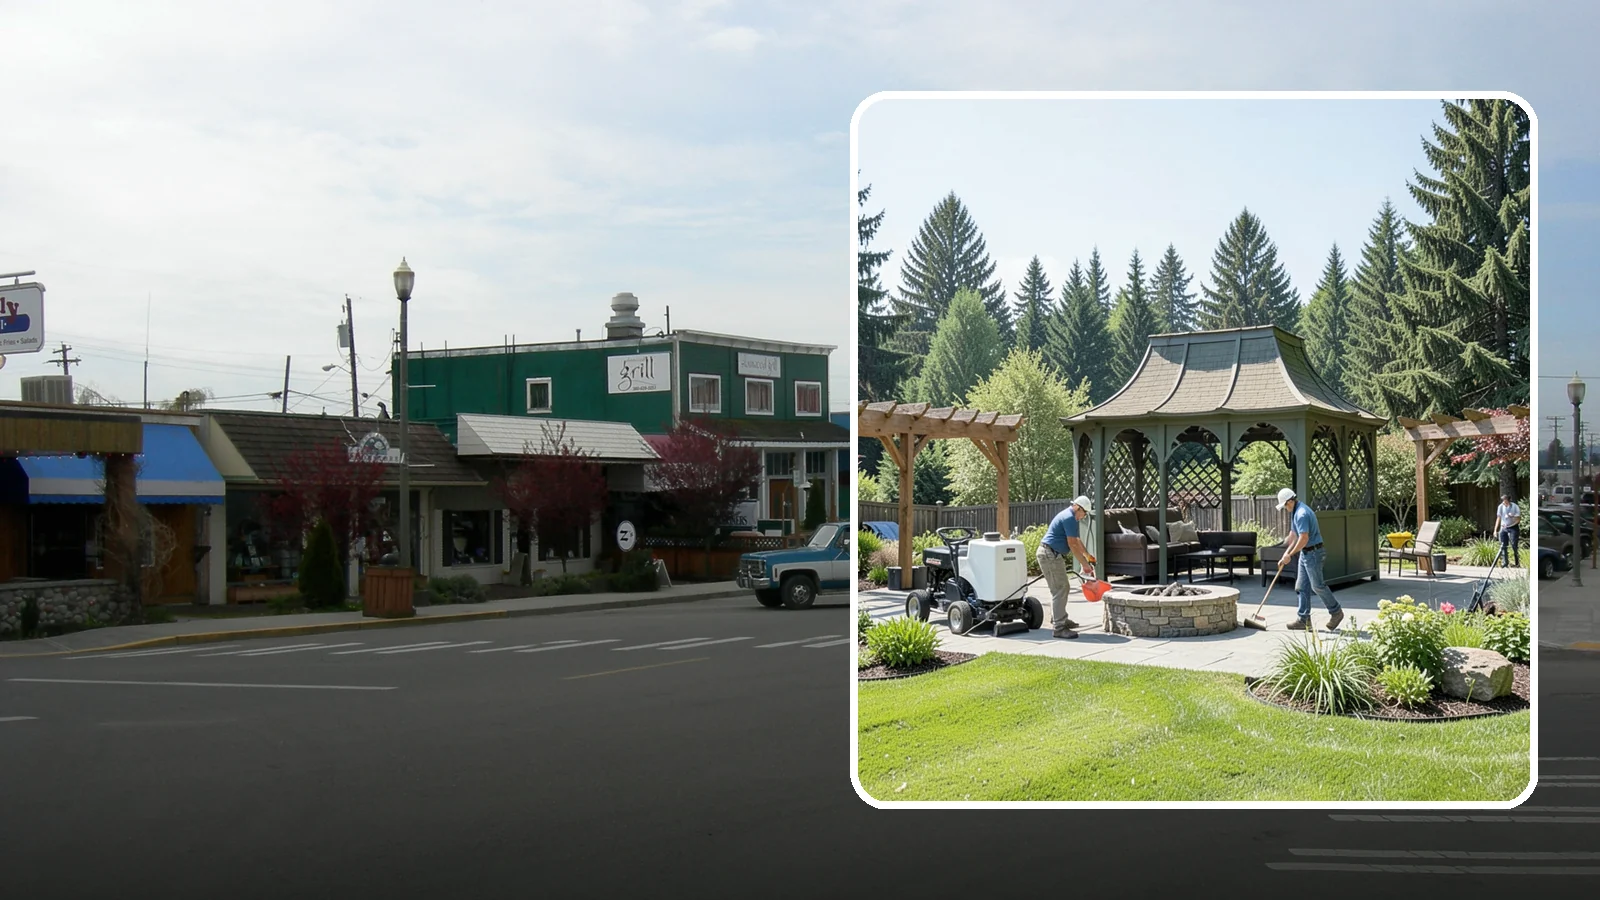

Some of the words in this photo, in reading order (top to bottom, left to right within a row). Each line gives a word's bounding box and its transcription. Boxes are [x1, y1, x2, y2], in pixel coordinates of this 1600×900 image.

[3, 338, 16, 346] Fries
[20, 337, 38, 345] Salads
[618, 356, 655, 391] grill
